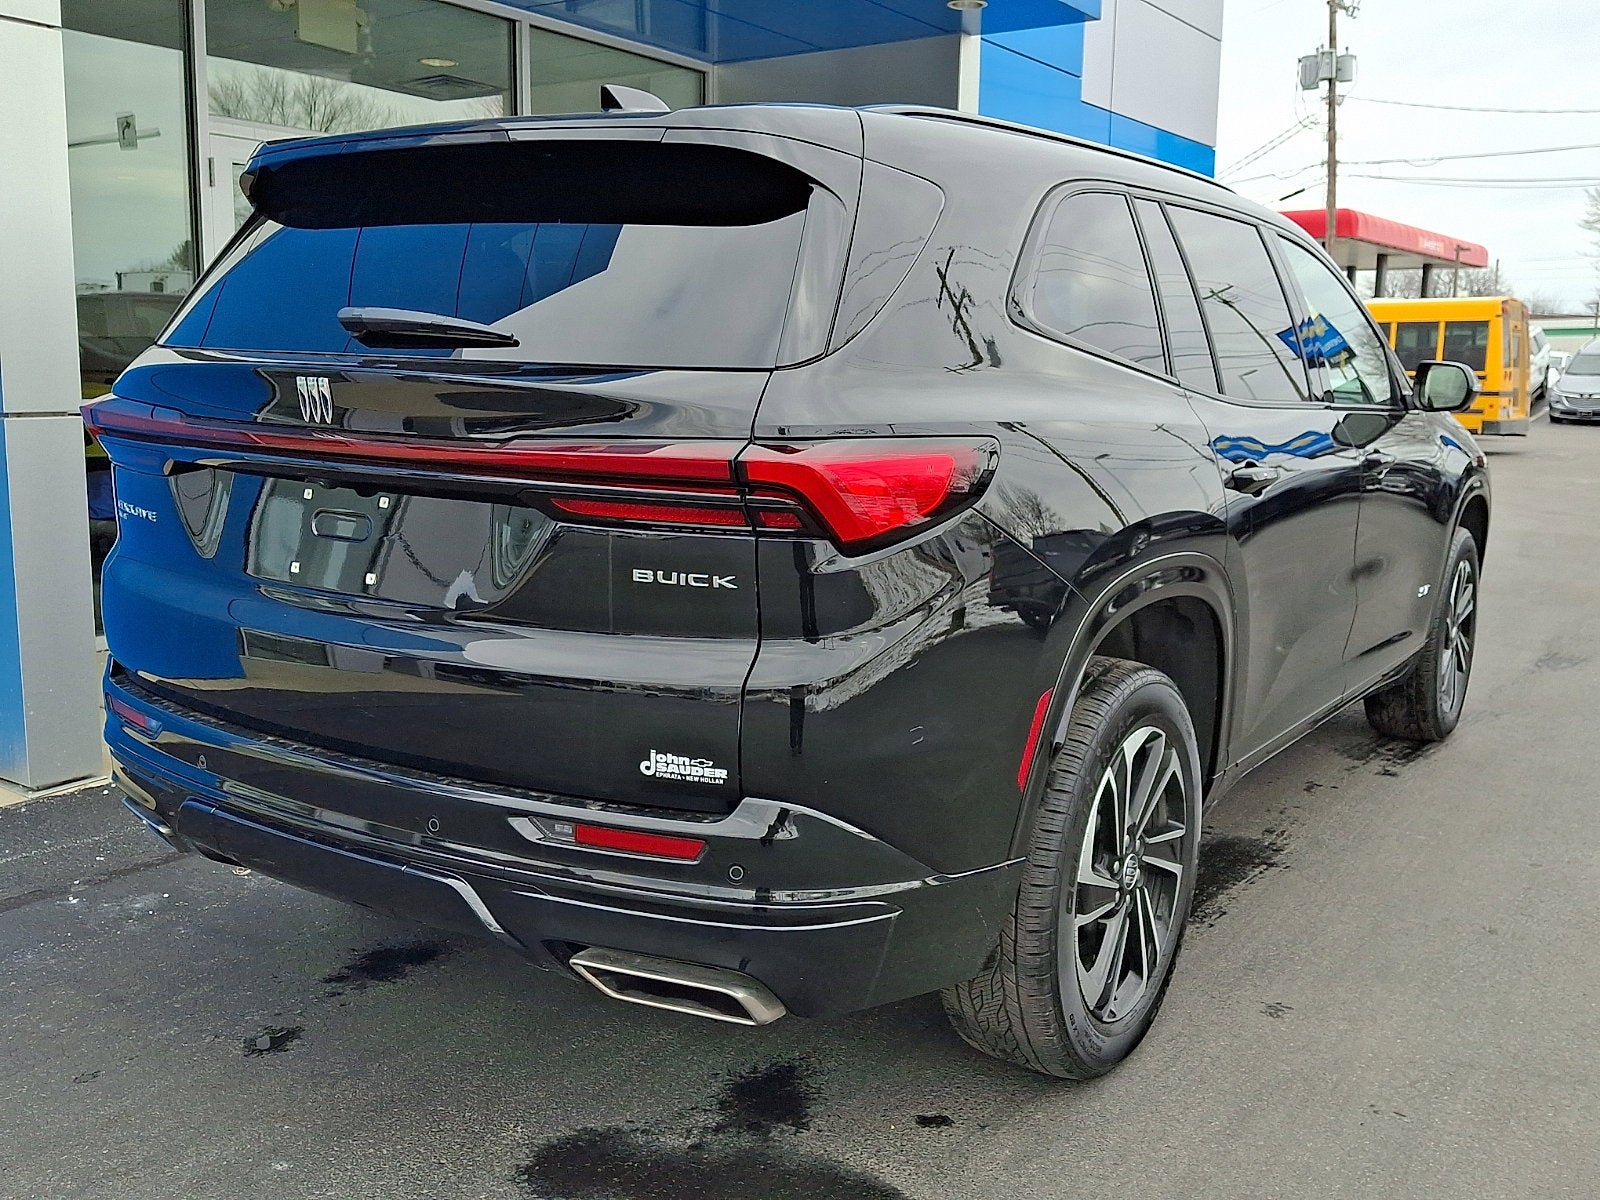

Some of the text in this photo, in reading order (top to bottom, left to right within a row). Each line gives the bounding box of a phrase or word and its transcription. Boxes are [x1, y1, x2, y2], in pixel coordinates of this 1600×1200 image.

[632, 568, 738, 589] BUICK
[656, 762, 728, 779] SAUDER
[656, 771, 682, 781] EPHRATA
[686, 775, 700, 783] NEW
